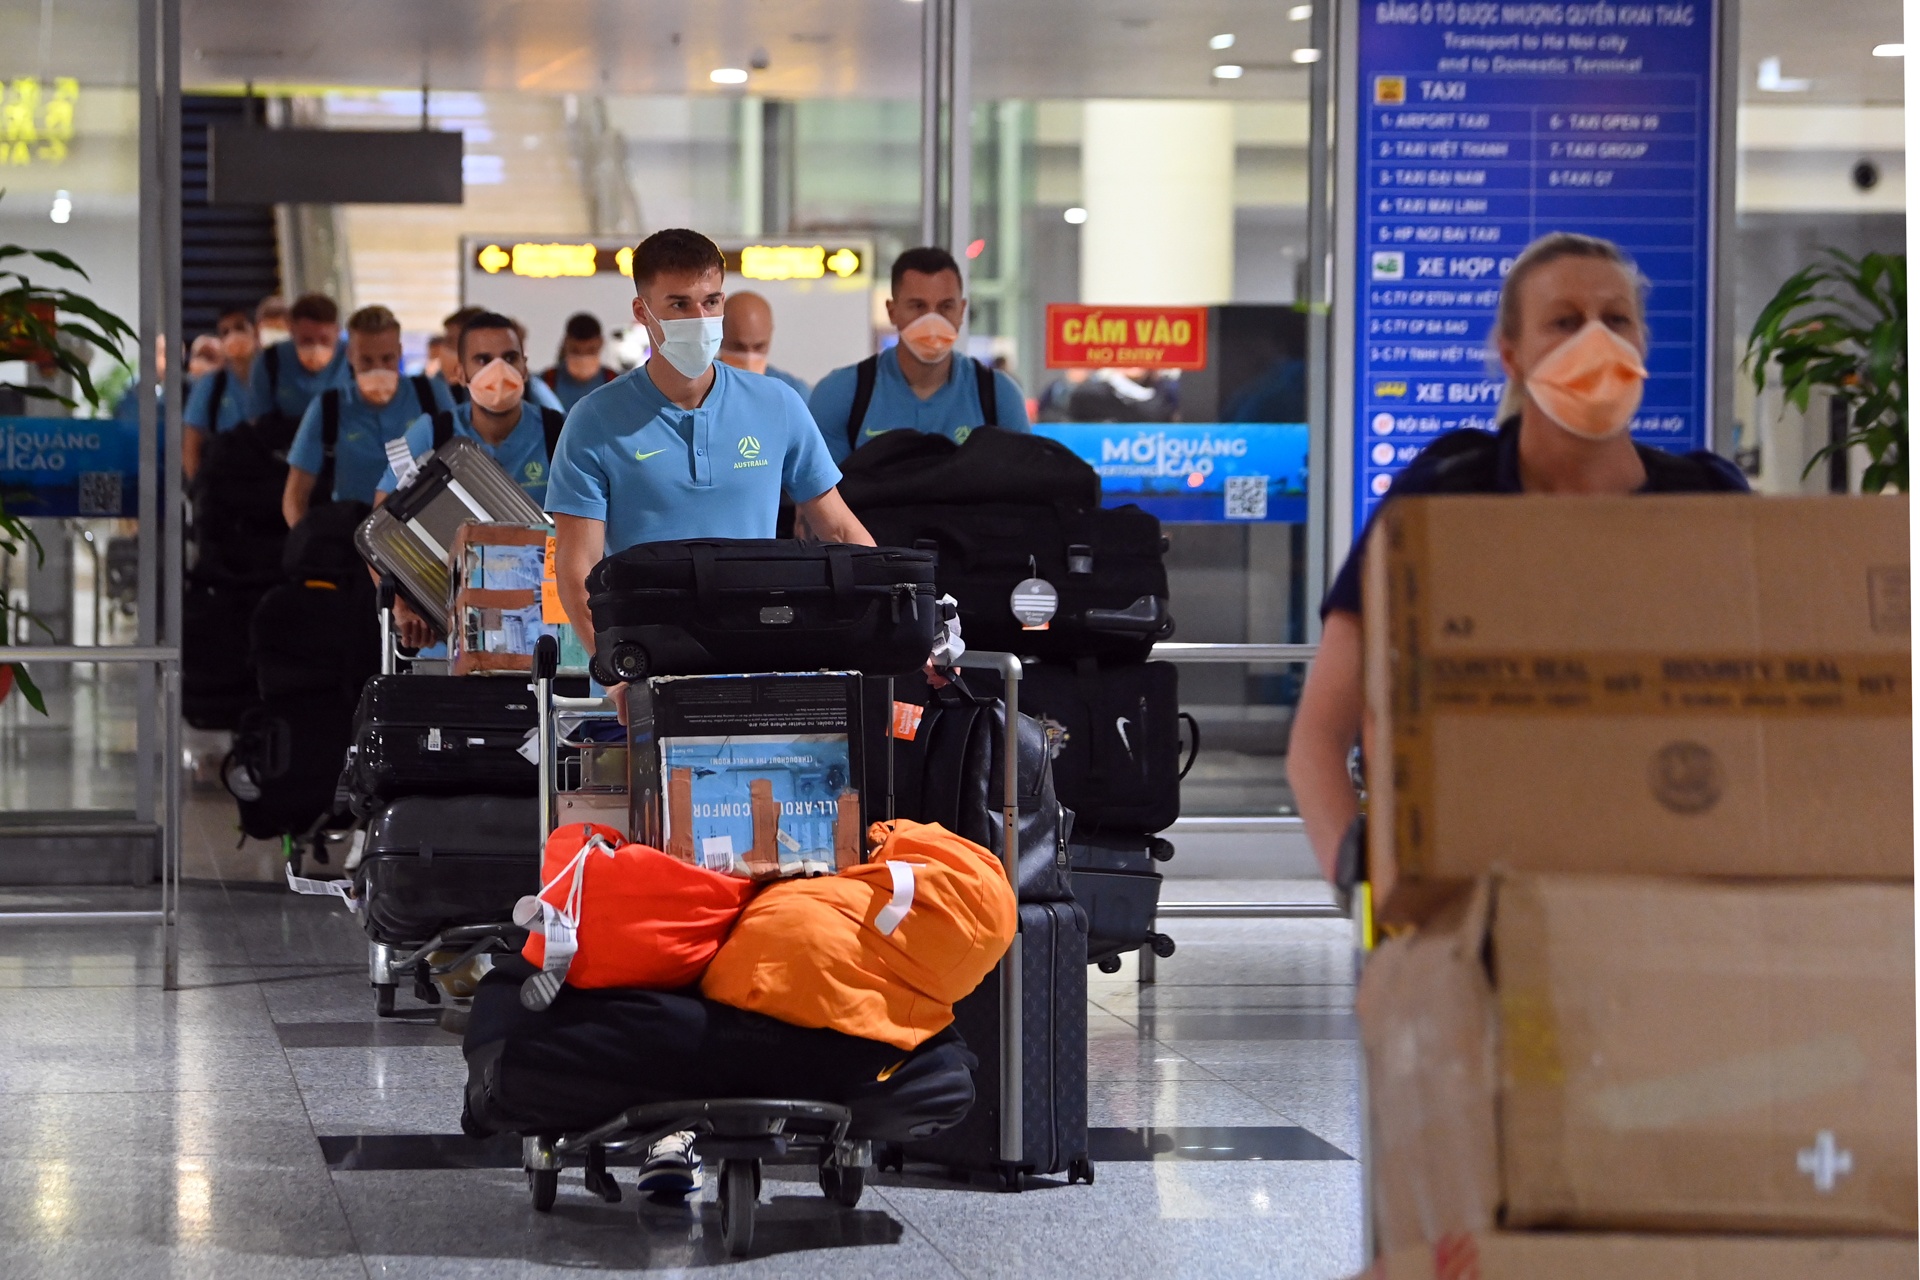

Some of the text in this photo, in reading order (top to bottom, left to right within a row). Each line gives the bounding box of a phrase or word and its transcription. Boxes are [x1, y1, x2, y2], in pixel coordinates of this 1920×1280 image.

[1443, 31, 1520, 52] Transport
[1522, 34, 1540, 49] to
[1598, 34, 1628, 54] city
[1438, 55, 1643, 73] and to Domestic Terminal
[1420, 81, 1466, 100] TAXI
[1395, 112, 1455, 129] AIRPORT
[1458, 112, 1490, 129] TAXI
[1569, 113, 1601, 131] TAXI
[1601, 114, 1640, 131] OPEN
[1396, 140, 1427, 158] TAXI
[1461, 141, 1509, 158] THANH
[1565, 142, 1597, 158] TAXI
[1598, 142, 1649, 159] GROUP
[1396, 169, 1426, 187] TAXI
[1453, 169, 1486, 187] NAM
[1396, 197, 1426, 214] TAXI
[1427, 197, 1453, 214] MAI
[1455, 198, 1488, 214] LINH
[1468, 225, 1501, 243] TAXI
[1417, 256, 1445, 277] XE
[1449, 256, 1495, 280] HỢP
[1062, 309, 1191, 346] CẤM VÀO
[1086, 347, 1165, 364] NO ENTRY
[1416, 379, 1504, 403] XE BUÝT
[733, 459, 768, 469] AUSTRALIA
[710, 757, 730, 765] ROOM)
[755, 756, 767, 764] THE
[769, 755, 812, 763] (THROUGHOUT
[692, 802, 750, 817] COMFOR
